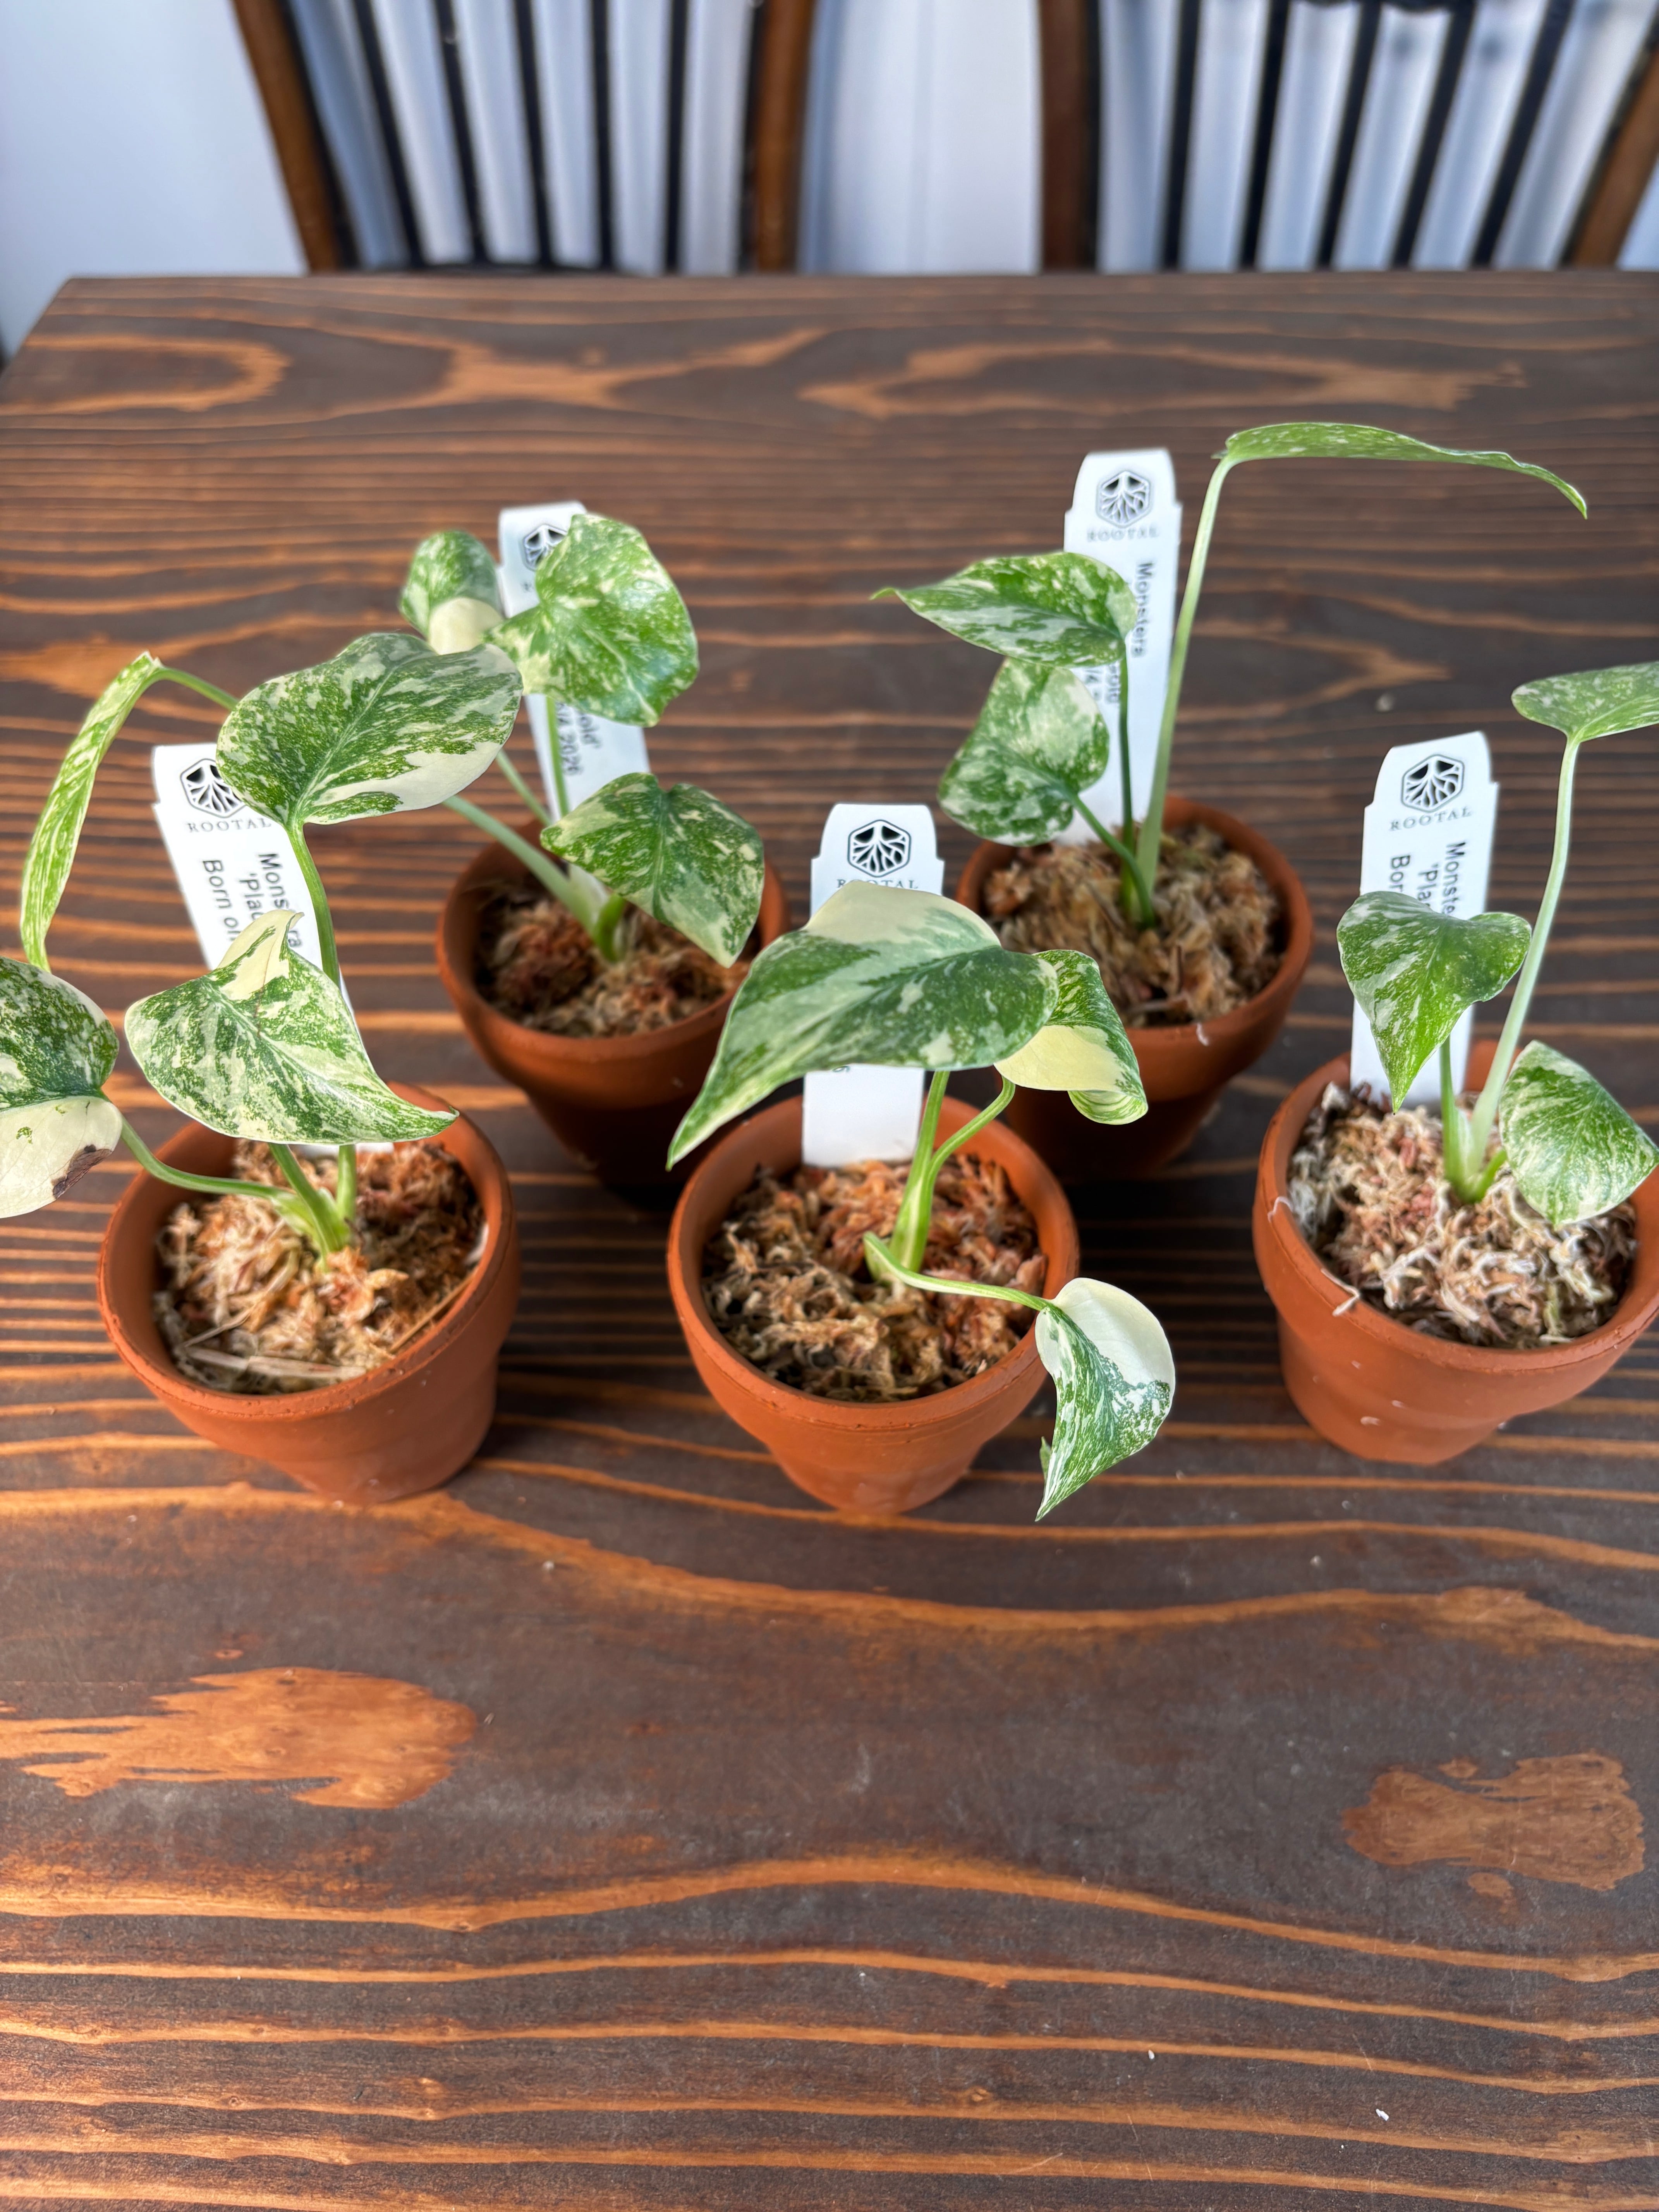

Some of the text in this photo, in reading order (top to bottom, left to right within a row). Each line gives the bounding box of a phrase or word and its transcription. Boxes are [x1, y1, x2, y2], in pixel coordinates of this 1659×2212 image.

[187, 818, 271, 833] ROOTAL
[1389, 807, 1472, 831] ROOTAL
[202, 860, 232, 908] Born
[837, 879, 919, 889] RTAL
[1389, 855, 1411, 892] Bor
[1441, 842, 1467, 915] Monste
[258, 853, 302, 948] Monsra
